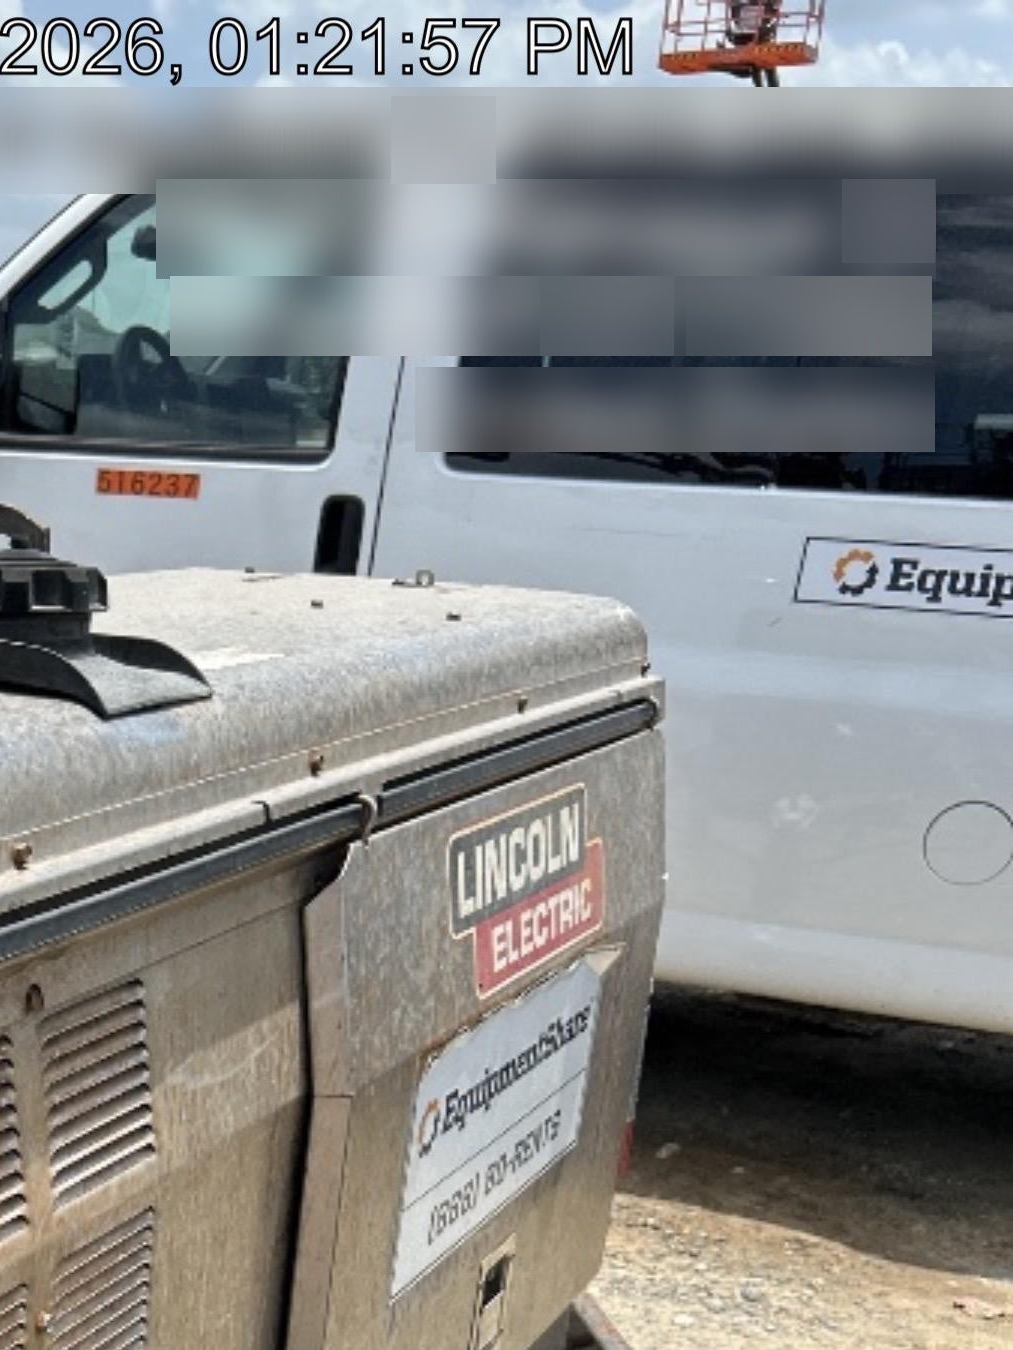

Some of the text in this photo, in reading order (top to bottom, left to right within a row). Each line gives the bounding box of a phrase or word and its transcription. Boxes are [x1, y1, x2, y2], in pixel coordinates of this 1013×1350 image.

[97, 471, 199, 499] 516237
[457, 803, 580, 918] LINCOLN
[492, 878, 592, 973] ELECTRIC
